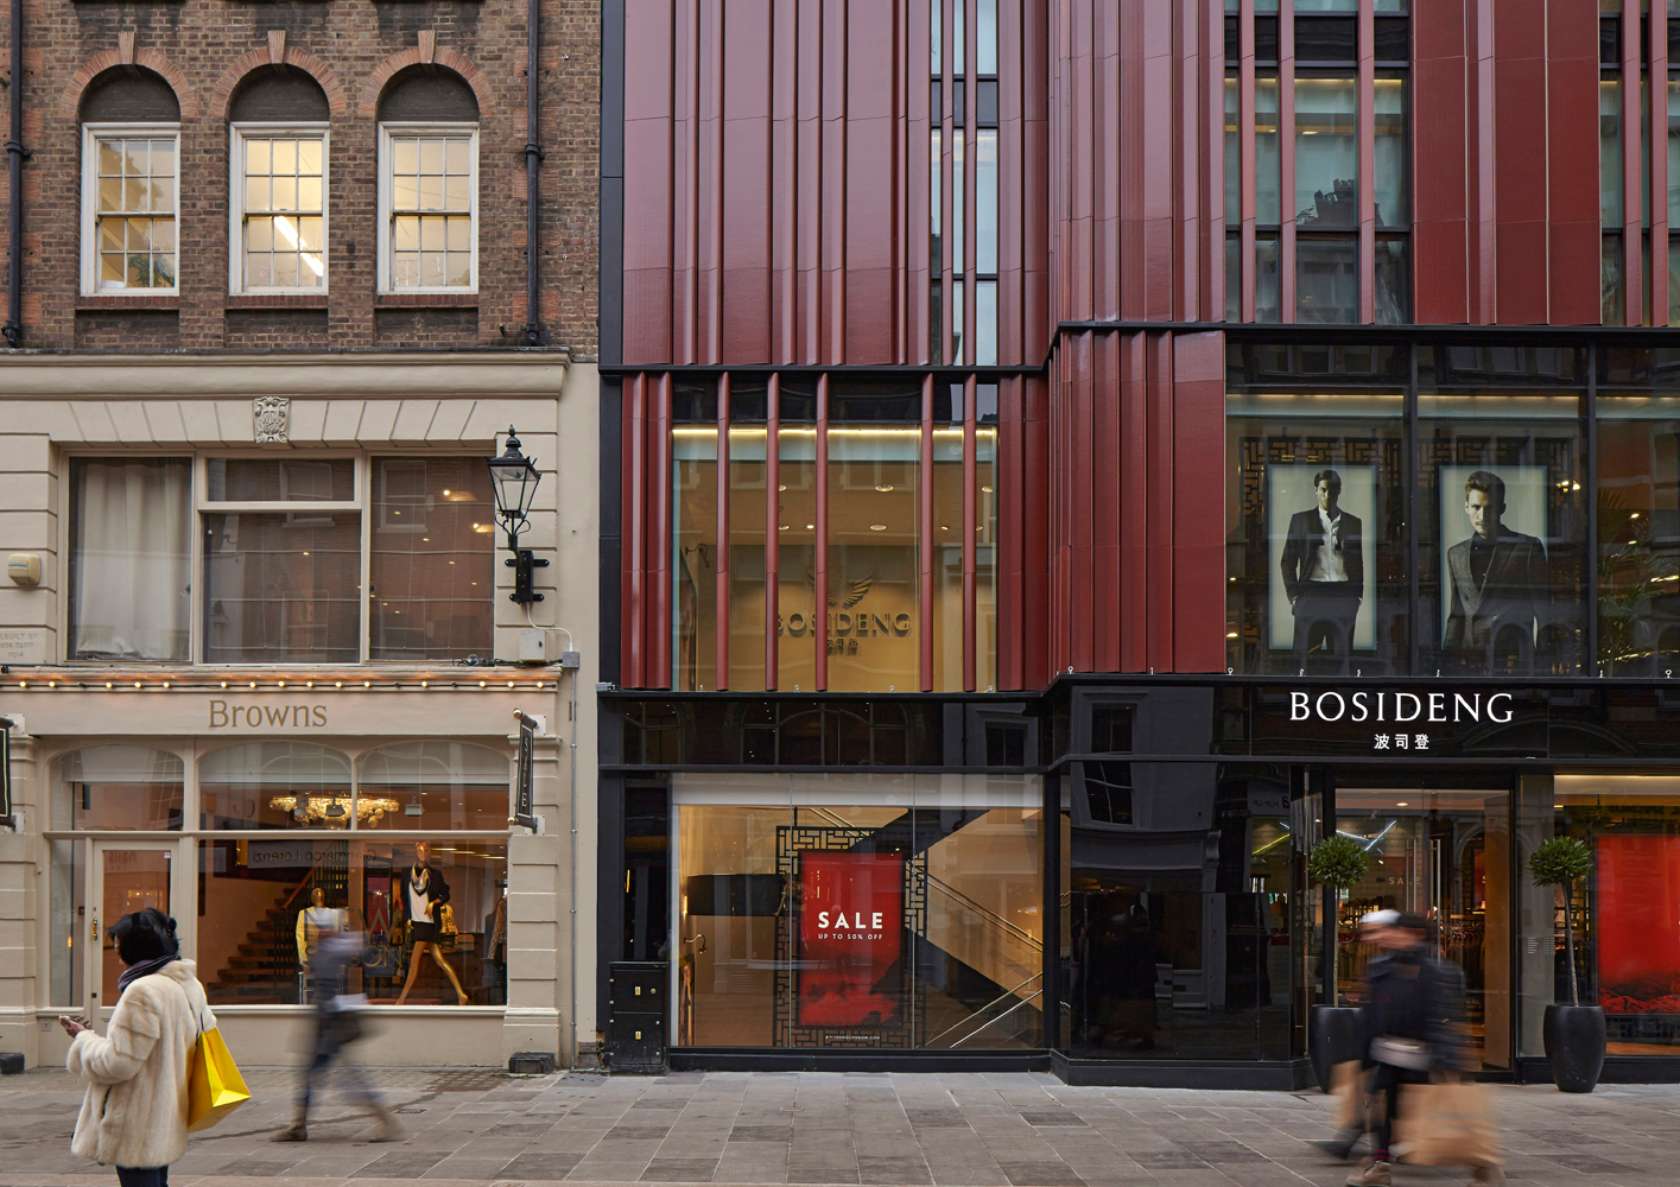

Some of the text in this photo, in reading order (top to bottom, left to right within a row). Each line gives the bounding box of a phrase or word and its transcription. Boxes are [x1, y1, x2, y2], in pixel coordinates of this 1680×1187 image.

[209, 699, 328, 728] Browns
[1289, 691, 1514, 723] BOSIDENG
[1373, 733, 1430, 750] 波司登
[817, 911, 883, 929] SALE
